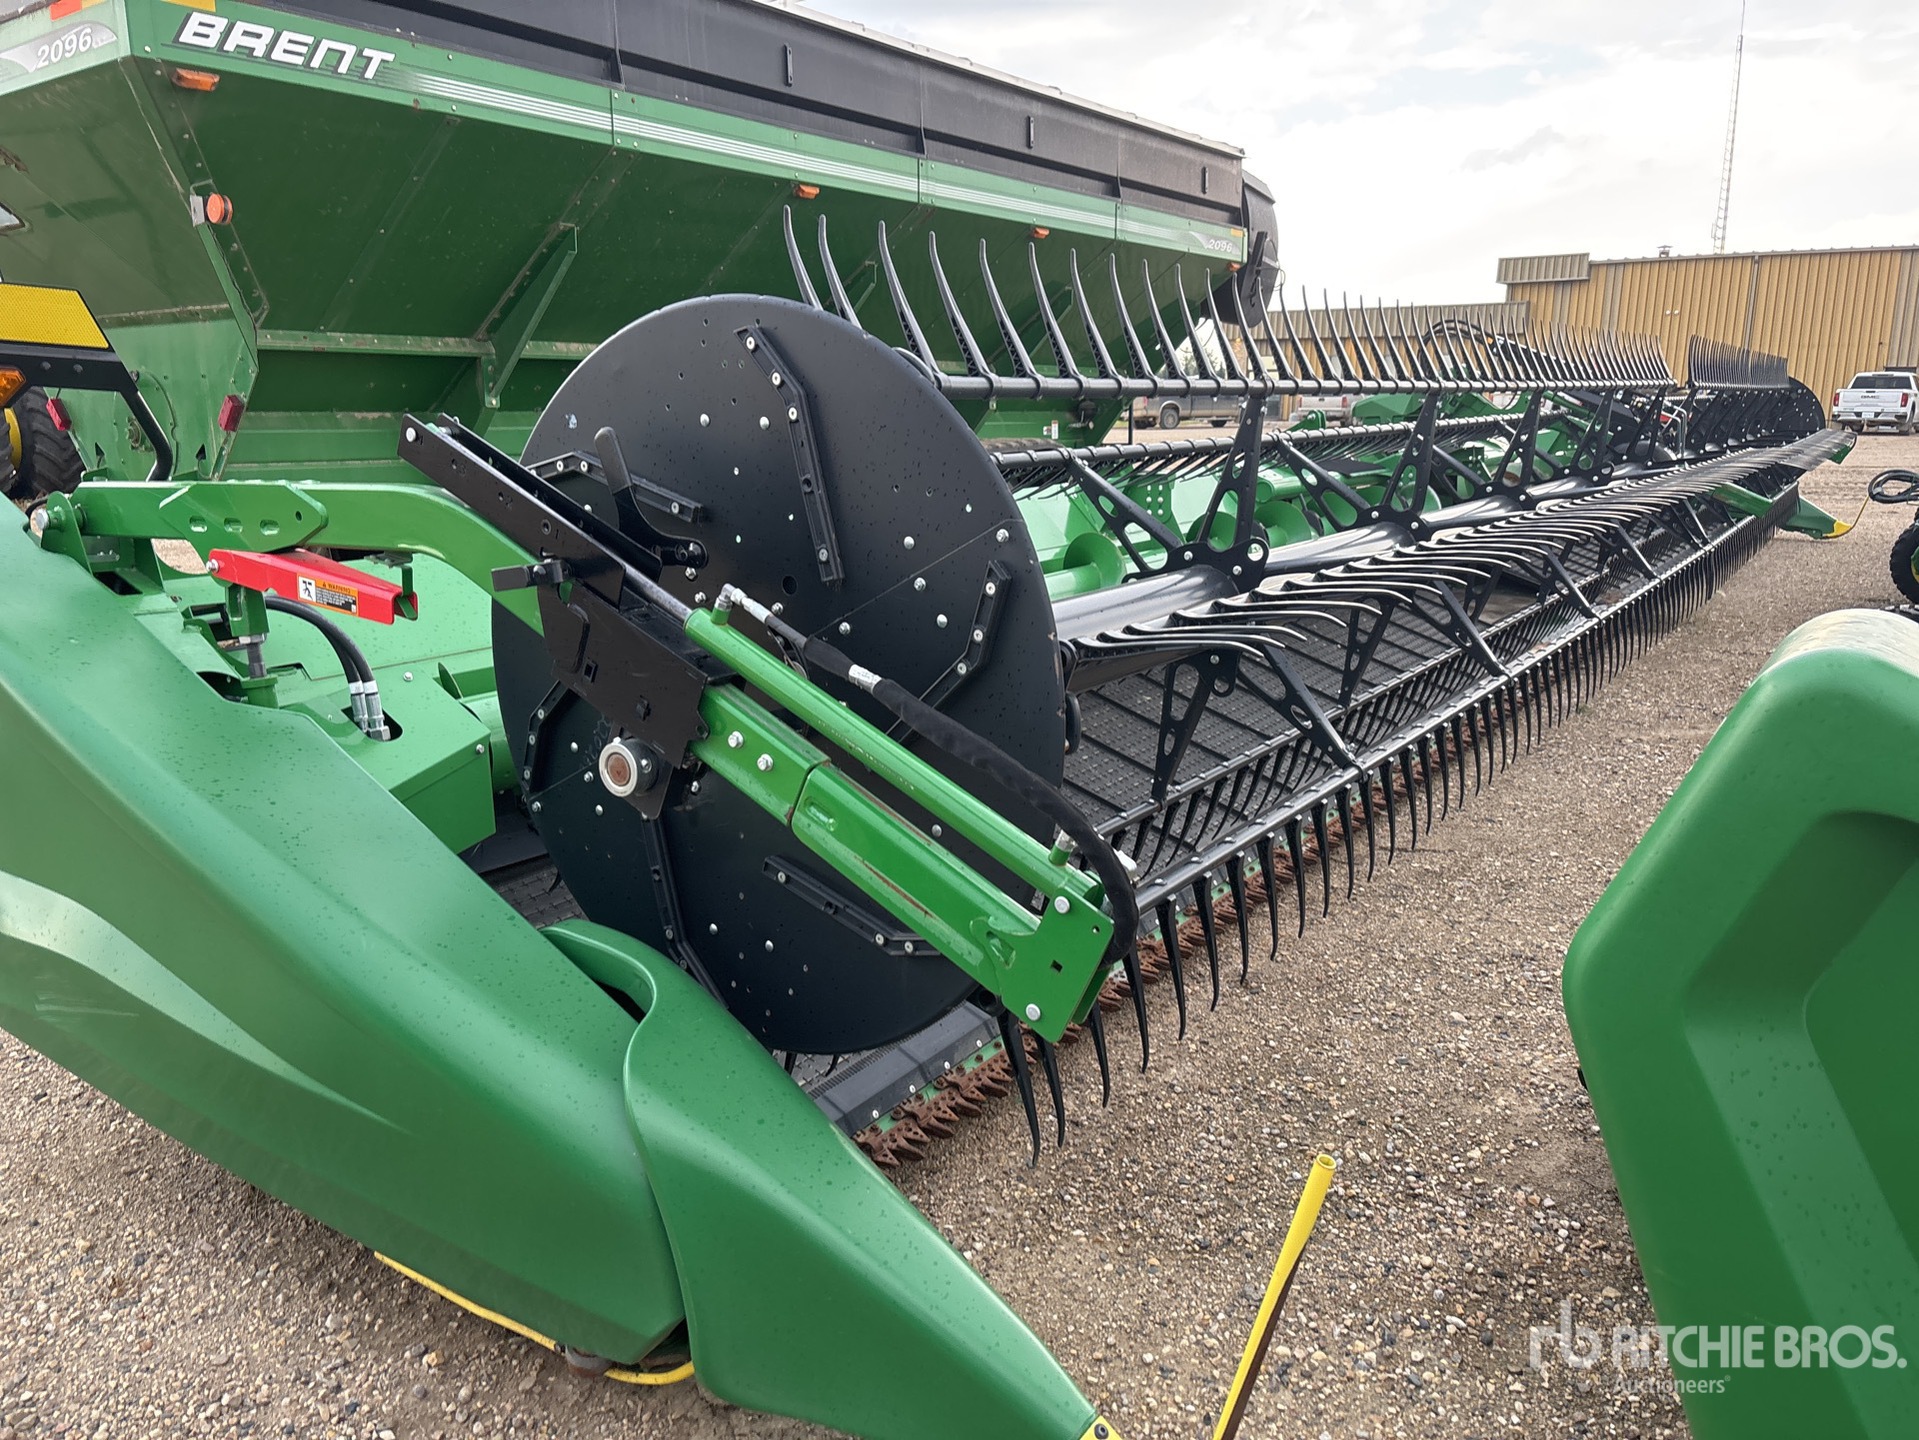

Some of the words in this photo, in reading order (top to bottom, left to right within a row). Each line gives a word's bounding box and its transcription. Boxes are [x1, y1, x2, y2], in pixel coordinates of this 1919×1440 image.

[36, 26, 93, 70] 2096
[176, 12, 396, 80] BRENT
[1208, 239, 1232, 252] 2096
